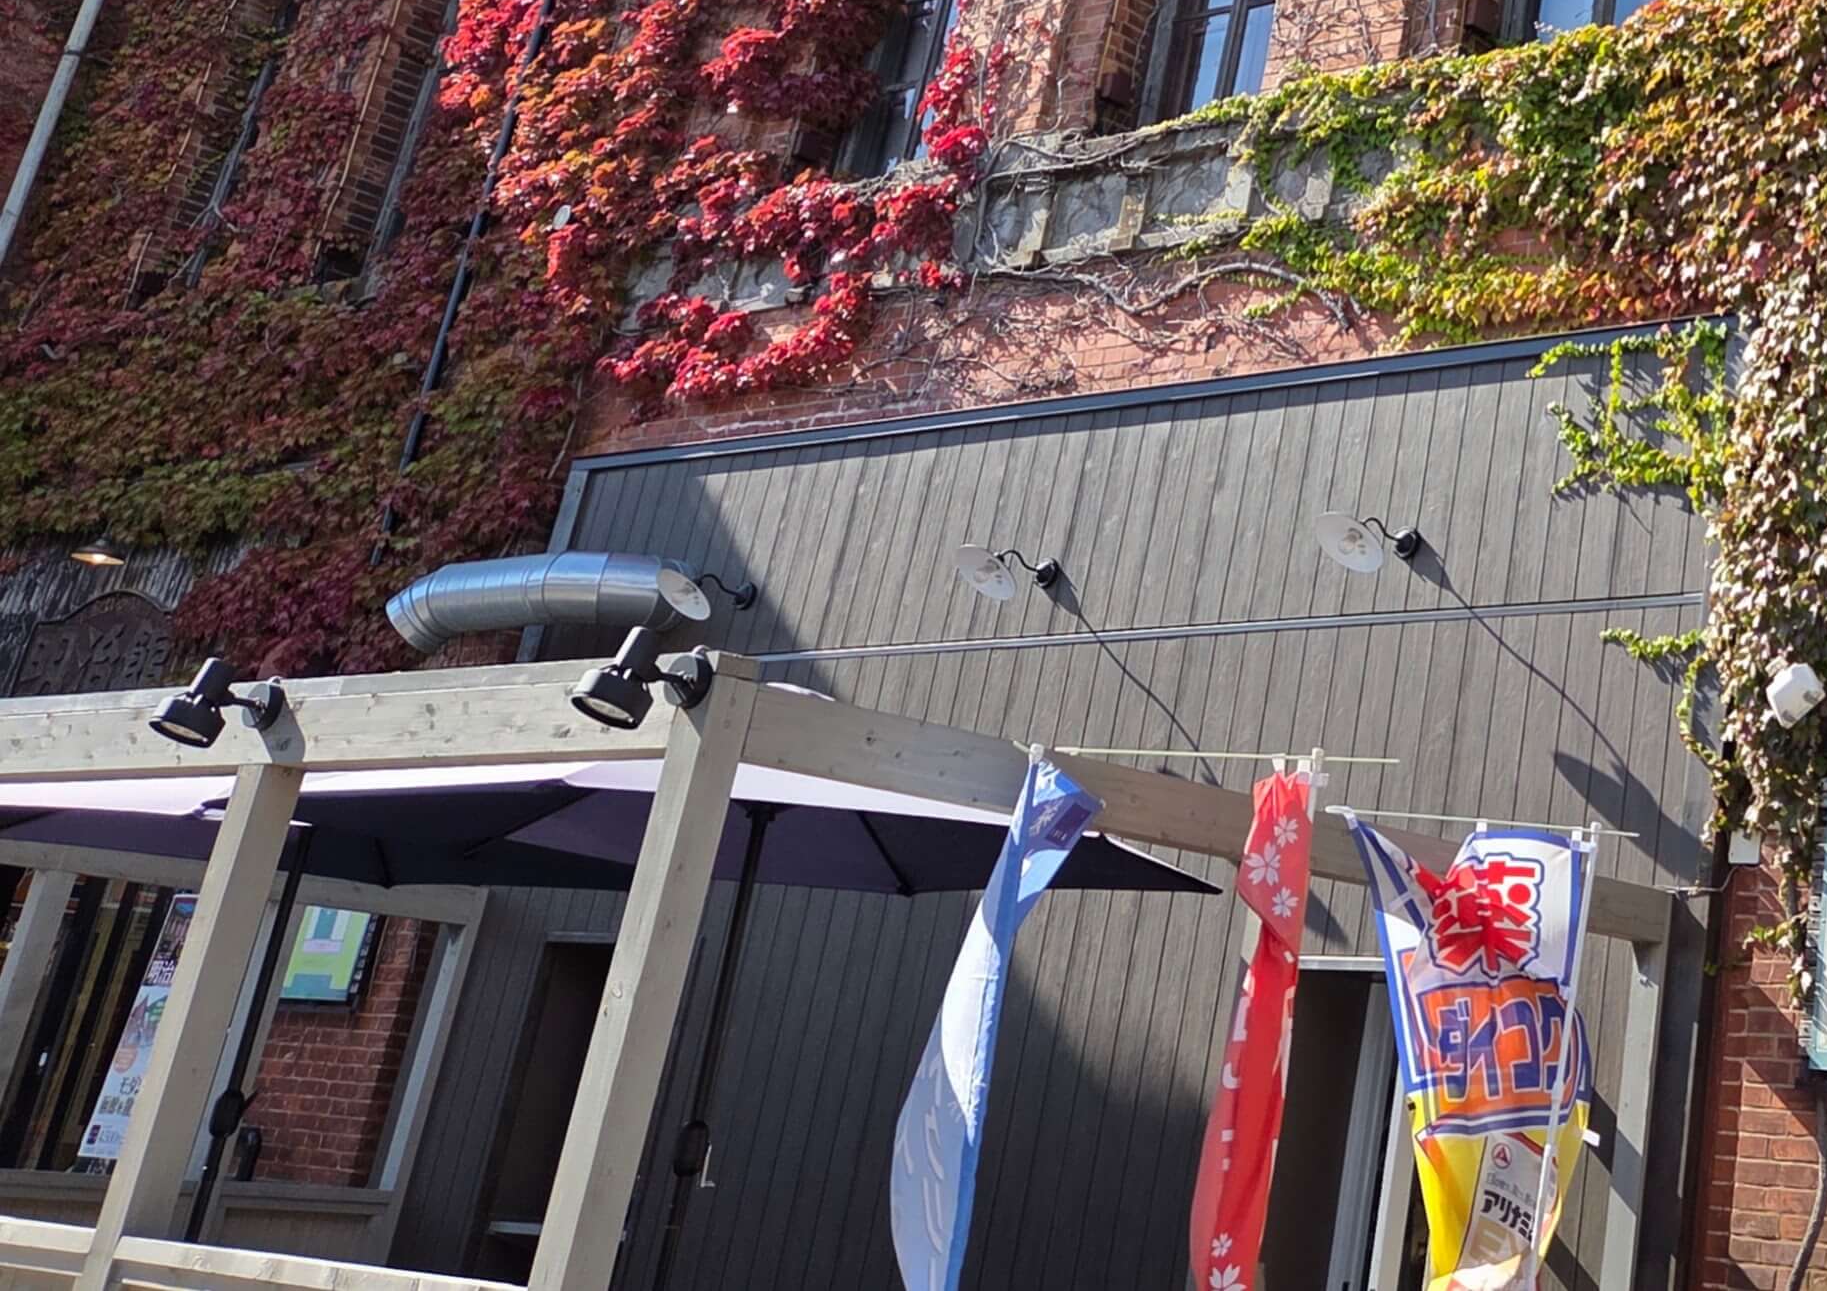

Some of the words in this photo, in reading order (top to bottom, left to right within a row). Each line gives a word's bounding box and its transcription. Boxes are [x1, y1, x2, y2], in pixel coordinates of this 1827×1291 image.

[1408, 857, 1538, 973] 薬
[1436, 995, 1575, 1103] ダイコク
[1480, 1190, 1536, 1242] アリナミ
